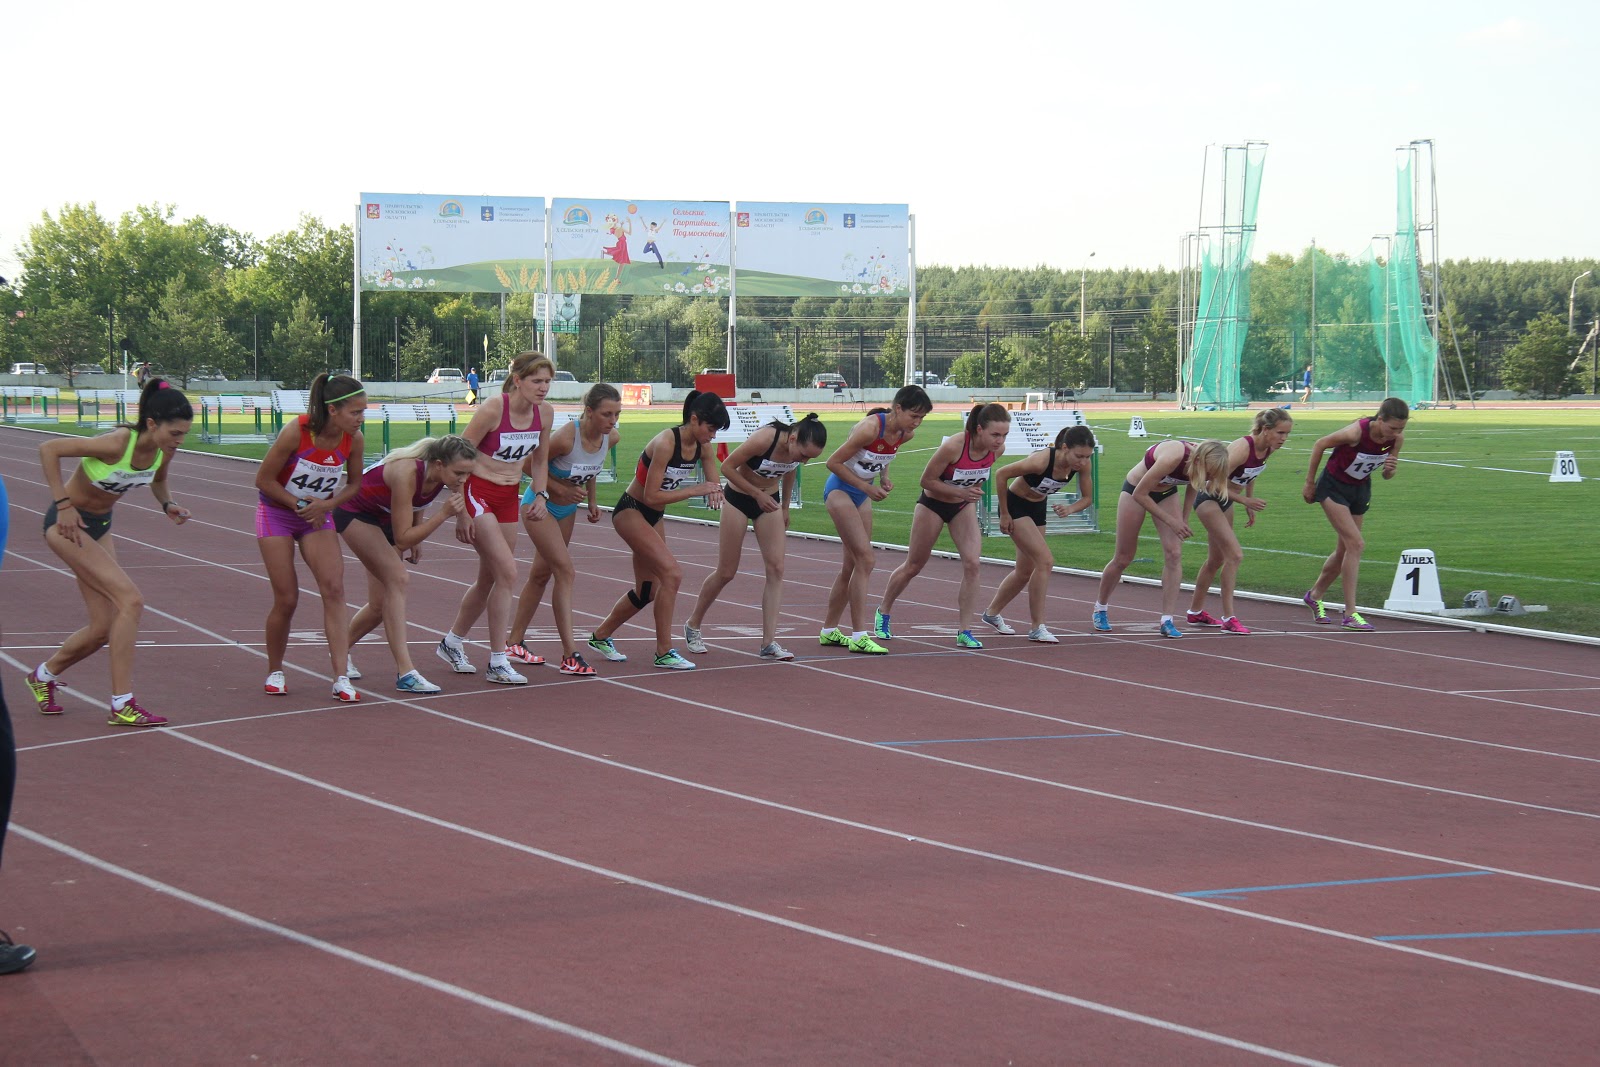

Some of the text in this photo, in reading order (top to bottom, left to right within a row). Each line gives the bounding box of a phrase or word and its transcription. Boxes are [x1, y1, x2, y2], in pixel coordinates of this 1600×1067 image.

[672, 208, 707, 216] Сельские.
[672, 218, 720, 228] Спортивные.
[1133, 420, 1143, 430] 50
[1561, 459, 1575, 475] 80
[291, 473, 338, 492] 442
[1401, 554, 1434, 564] Vinex
[1406, 567, 1420, 596] 1
